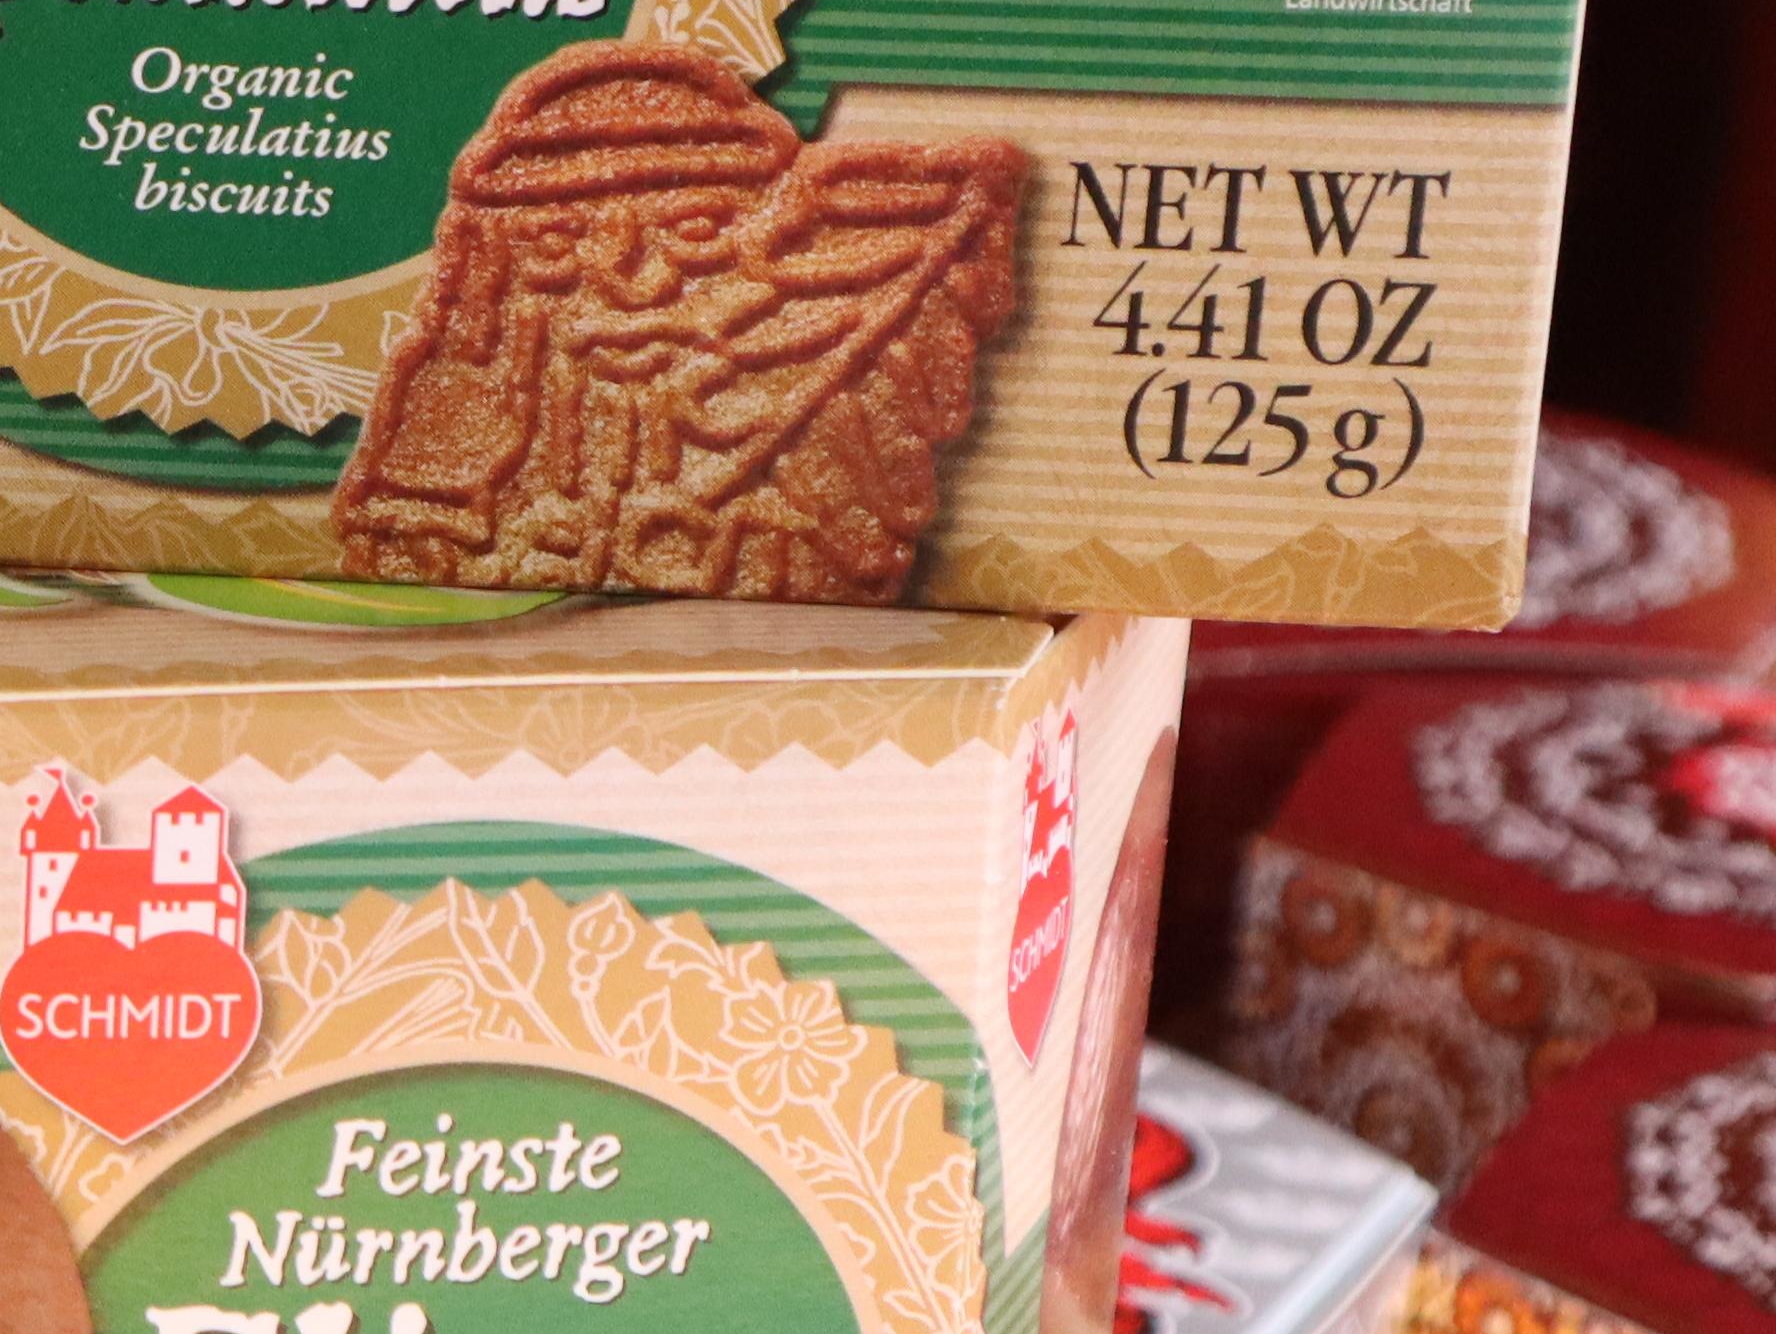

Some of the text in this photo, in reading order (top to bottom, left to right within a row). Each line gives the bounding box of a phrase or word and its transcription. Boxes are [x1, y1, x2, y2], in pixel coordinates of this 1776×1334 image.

[130, 46, 354, 103] Organic
[79, 103, 391, 166] Speculatius
[134, 163, 335, 220] biscuits
[1060, 161, 1452, 260] NET WT
[1092, 260, 1438, 368] 4.41 OZ
[1122, 368, 1426, 499] (125 g)
[1008, 895, 1070, 994] SCHMIDT
[14, 991, 243, 1042] SCHMIDT
[316, 1113, 625, 1199] Feinste
[218, 1198, 712, 1305] Nürnberger
